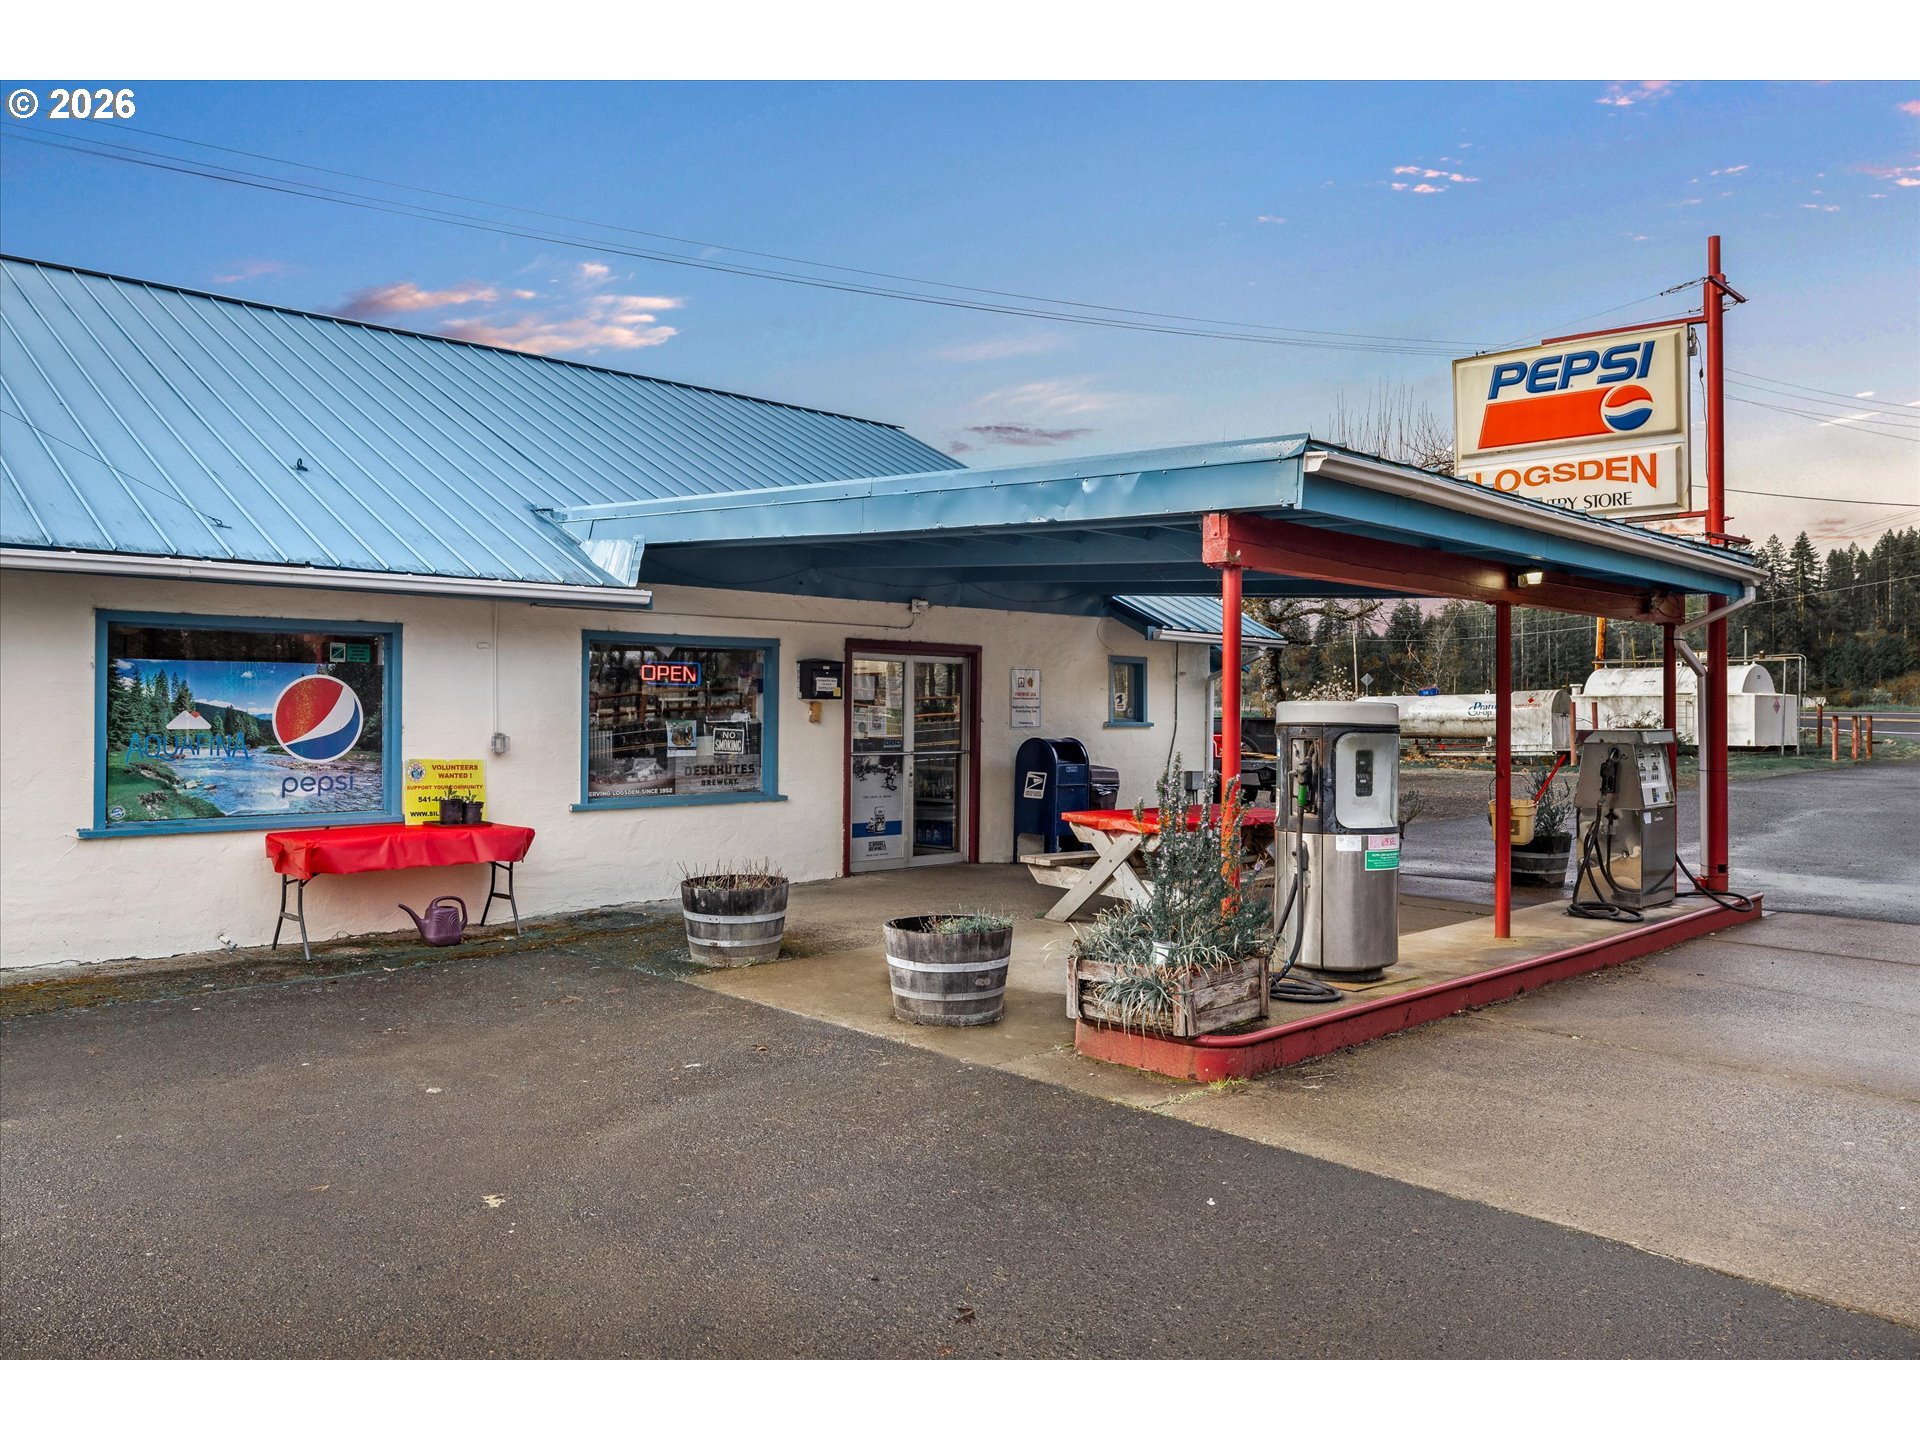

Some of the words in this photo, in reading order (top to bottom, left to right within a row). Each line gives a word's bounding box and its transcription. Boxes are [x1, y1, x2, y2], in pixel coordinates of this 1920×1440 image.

[1487, 340, 1656, 400] PEPSI
[1583, 491, 1633, 509] STORE
[641, 664, 697, 682] OPEN
[722, 731, 736, 739] NO
[125, 731, 249, 764] AQUAFINA
[714, 739, 742, 752] SMOKING
[684, 764, 755, 776] DESCHUTES
[281, 770, 354, 798] pepsi
[612, 788, 640, 796] LOGSDEN
